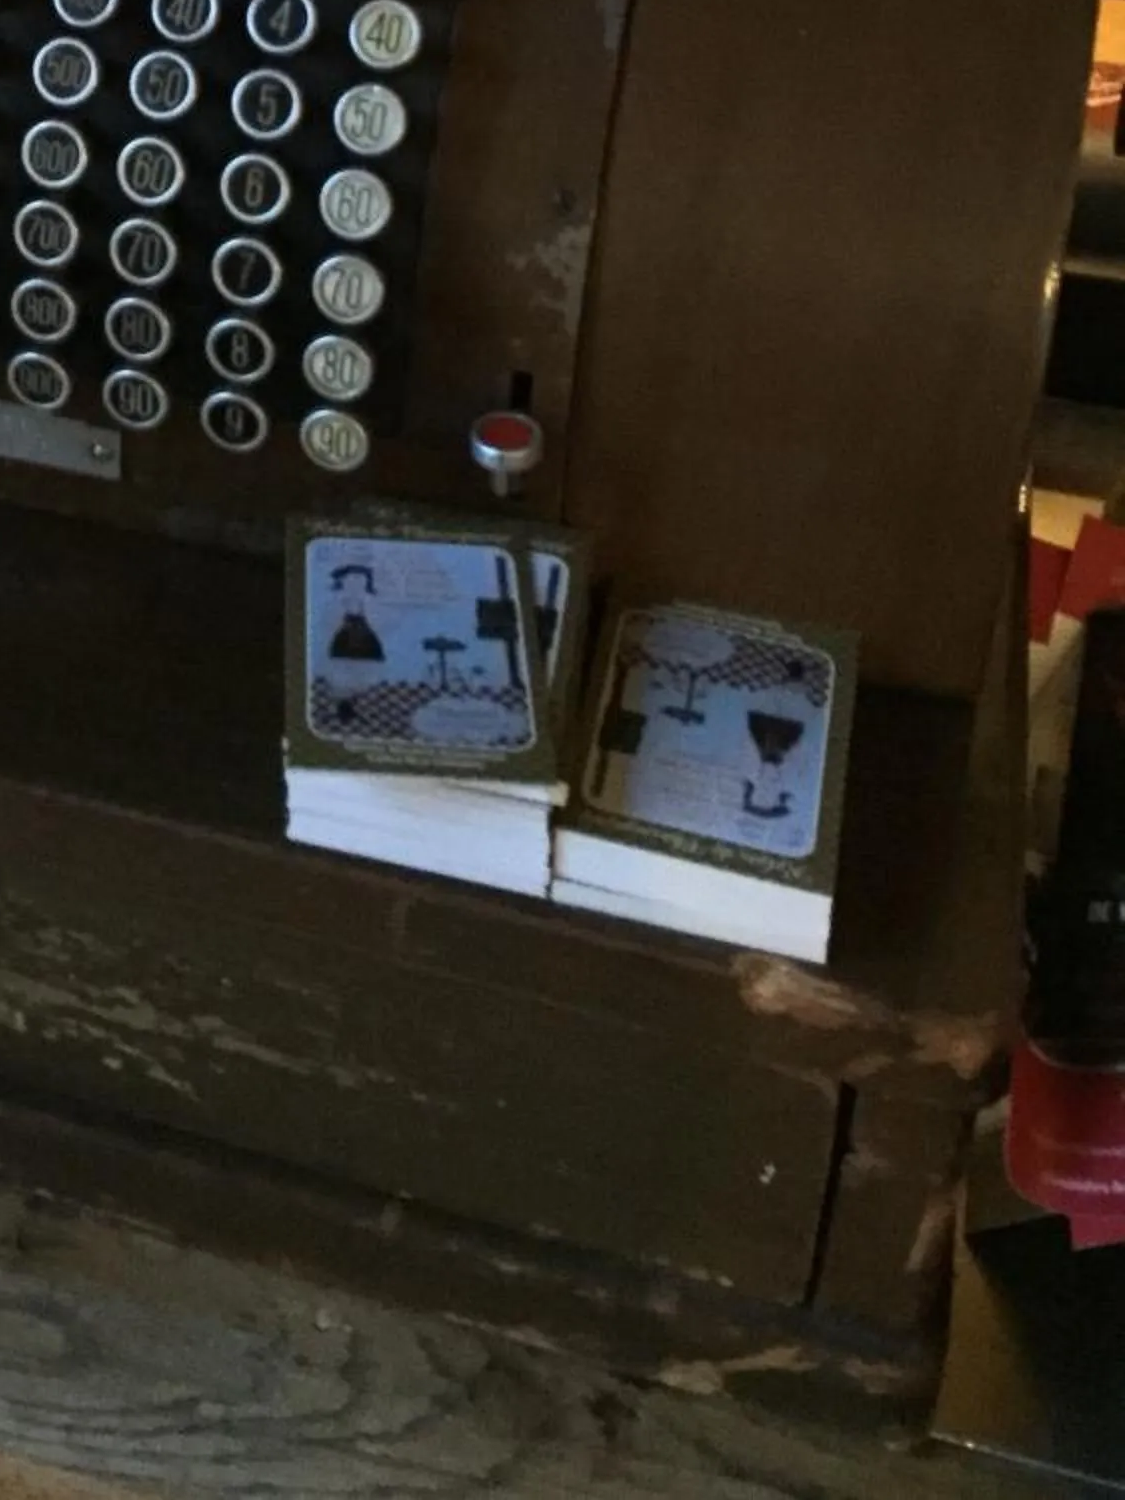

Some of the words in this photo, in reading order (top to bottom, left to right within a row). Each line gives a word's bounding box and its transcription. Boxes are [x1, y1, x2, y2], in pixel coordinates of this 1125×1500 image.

[270, 0, 293, 38] 4
[365, 11, 403, 52] 40
[147, 69, 184, 105] 50
[257, 84, 277, 126] 5
[348, 98, 387, 140] 50
[132, 149, 171, 192] 60
[245, 168, 264, 208] 6
[336, 183, 371, 218] 60
[26, 215, 69, 250] 700
[126, 231, 161, 272] 70
[237, 252, 257, 290] 7
[329, 267, 364, 306] 70
[119, 311, 157, 349] 80
[230, 330, 250, 368] 8
[322, 349, 358, 389] 80
[117, 380, 153, 417] 90
[224, 405, 243, 439] 9
[318, 425, 355, 460] 90
